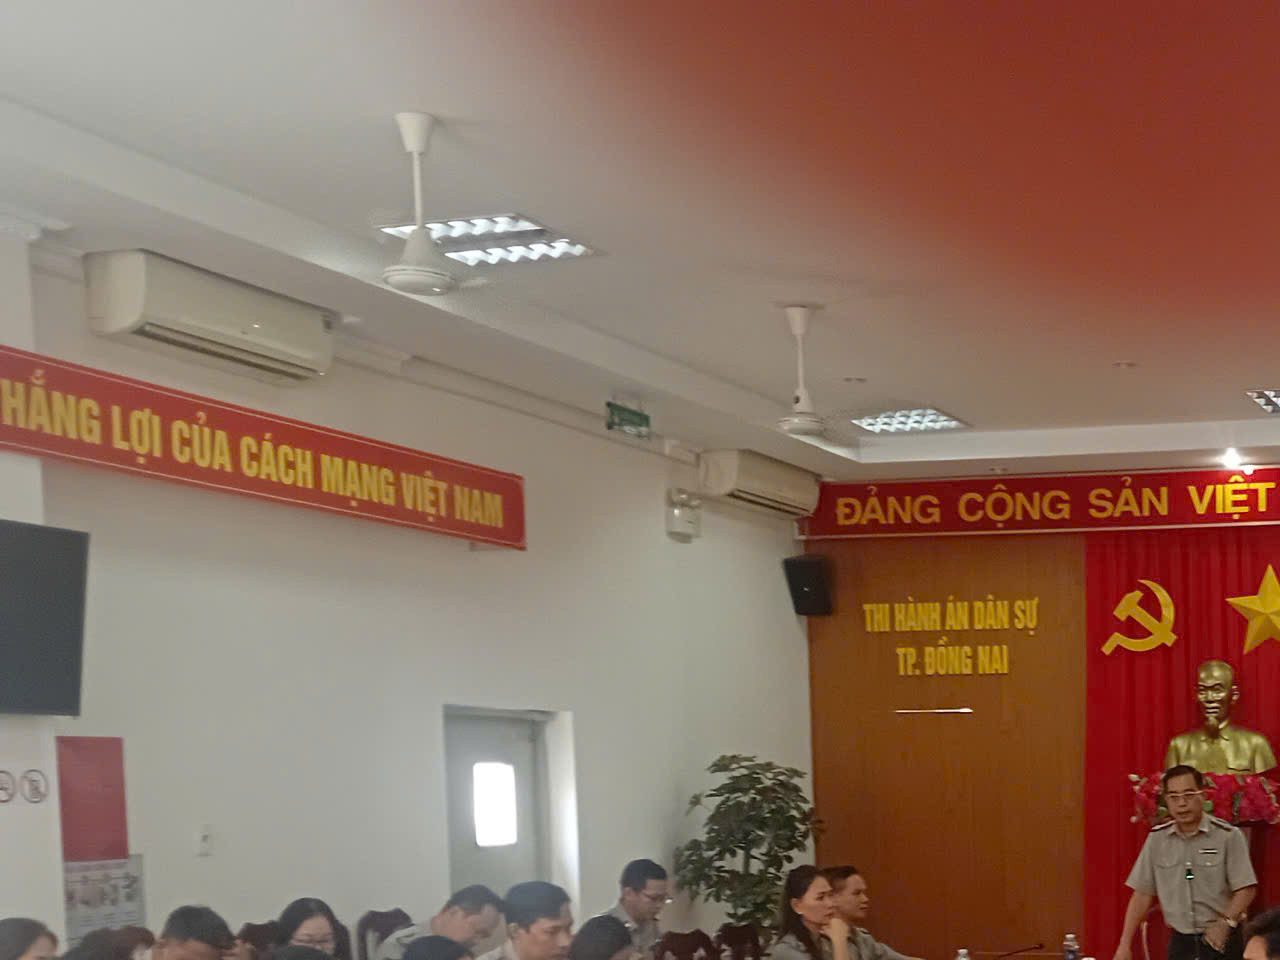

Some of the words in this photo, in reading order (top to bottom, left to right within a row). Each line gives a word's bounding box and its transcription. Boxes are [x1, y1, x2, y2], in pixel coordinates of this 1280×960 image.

[0, 370, 101, 444] HẮNG
[111, 404, 161, 463] LỢI
[171, 411, 232, 473] CỦA
[240, 433, 313, 489] CÁCH
[321, 453, 396, 507] MẠNG
[400, 465, 448, 523] VIỆT
[454, 484, 503, 529] NAM
[836, 485, 941, 525] ĐẢNG
[958, 484, 1071, 528] CỘNG
[1088, 476, 1169, 518] SẢN
[1187, 474, 1275, 520] VIỆT
[863, 603, 890, 632] THI
[894, 595, 941, 632] HÀNH
[945, 595, 970, 631] ÁN
[973, 594, 1010, 630] DÂN
[1013, 596, 1039, 636] SỰ
[896, 647, 921, 676] TP.
[923, 636, 973, 675] ĐỒNG
[977, 645, 1009, 675] NAI
